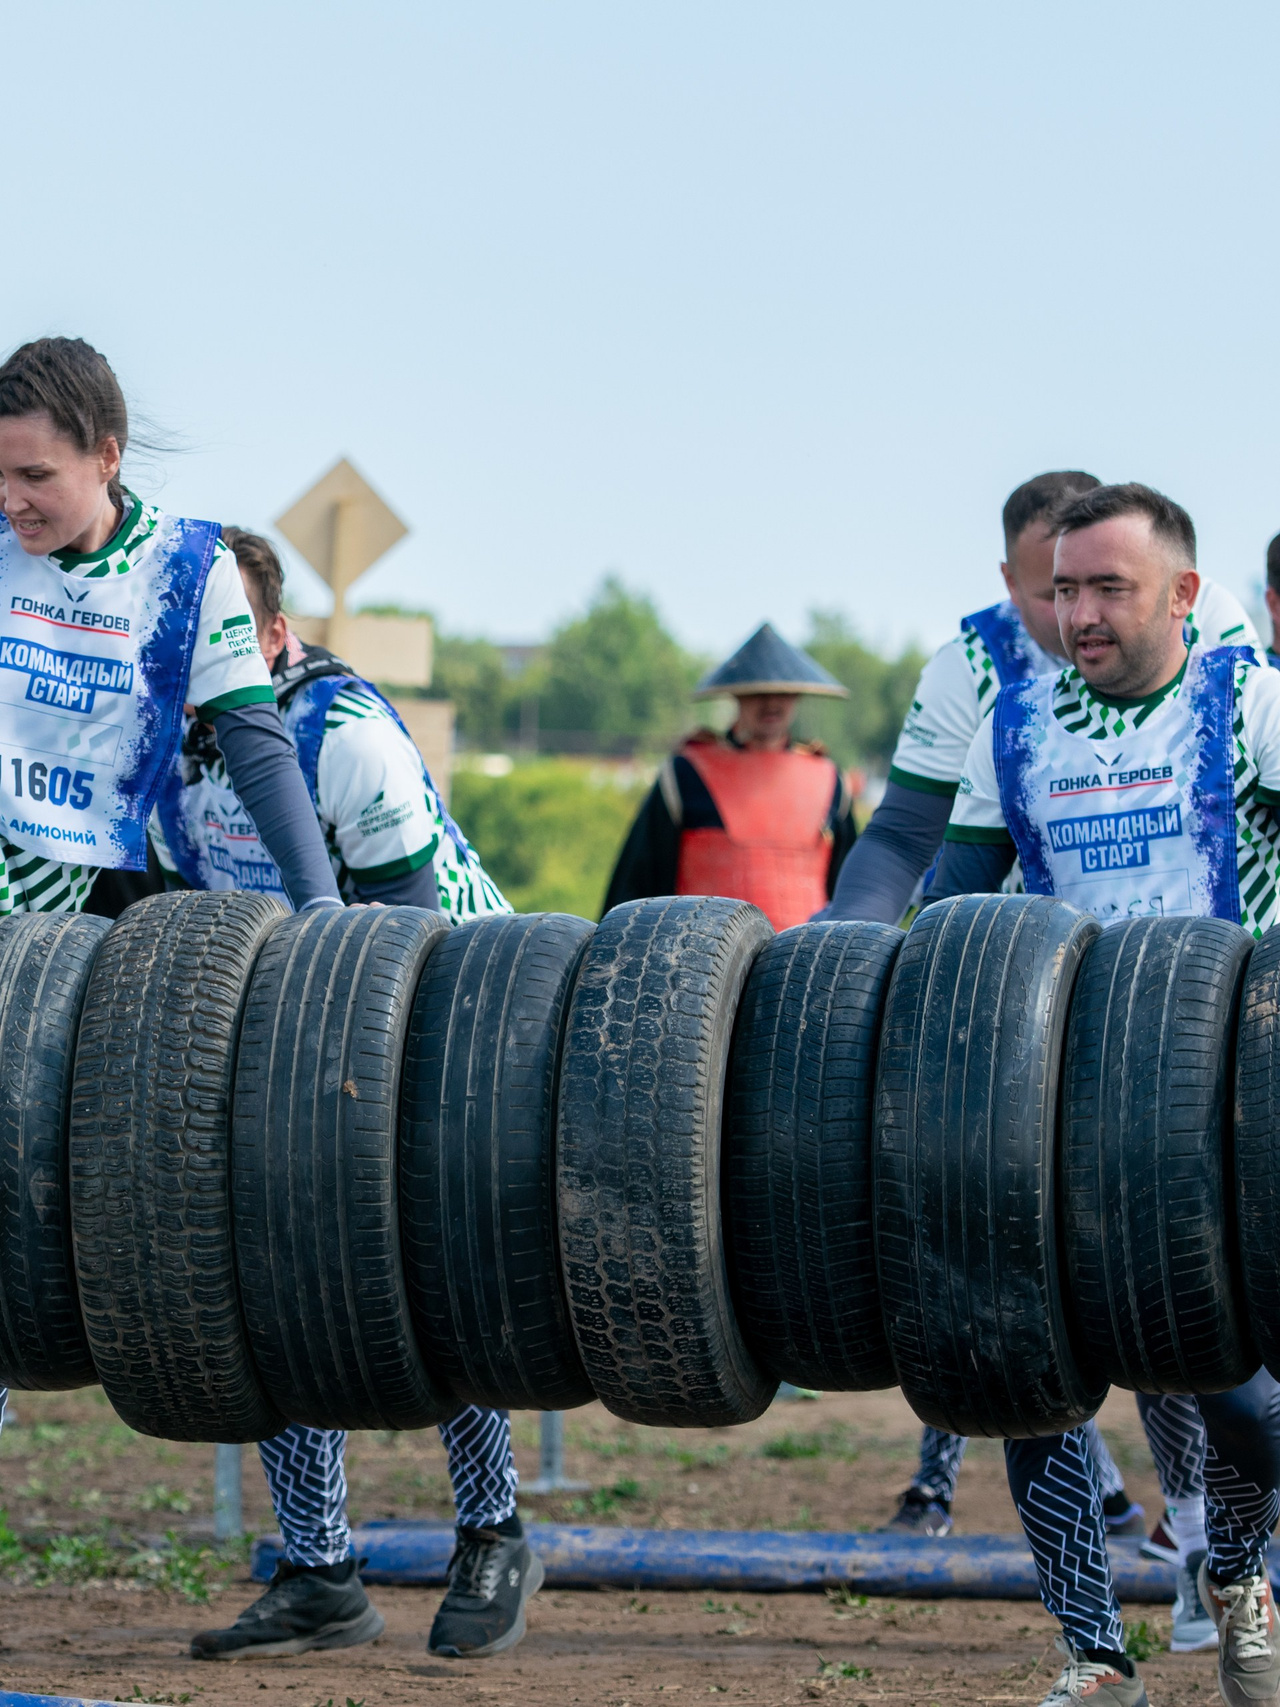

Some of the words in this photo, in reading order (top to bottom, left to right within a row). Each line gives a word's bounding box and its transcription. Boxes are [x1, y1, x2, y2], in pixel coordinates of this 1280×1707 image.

[10, 596, 66, 621] ГОНКА
[71, 609, 130, 632] ГЕРОЕВ
[225, 626, 253, 640] ЦЕНТР
[0, 641, 133, 690] КОМАНДНЫЙ
[30, 676, 91, 711] СТАРТ
[1049, 774, 1102, 793] ГОНКА
[1108, 766, 1173, 785] ГЕРОЕВ
[9, 818, 97, 846] АММОНИЙ
[229, 823, 257, 835] ГЕР
[1049, 804, 1179, 848] КОМАНДНЫЙ
[1084, 841, 1144, 870] СТАРТ
